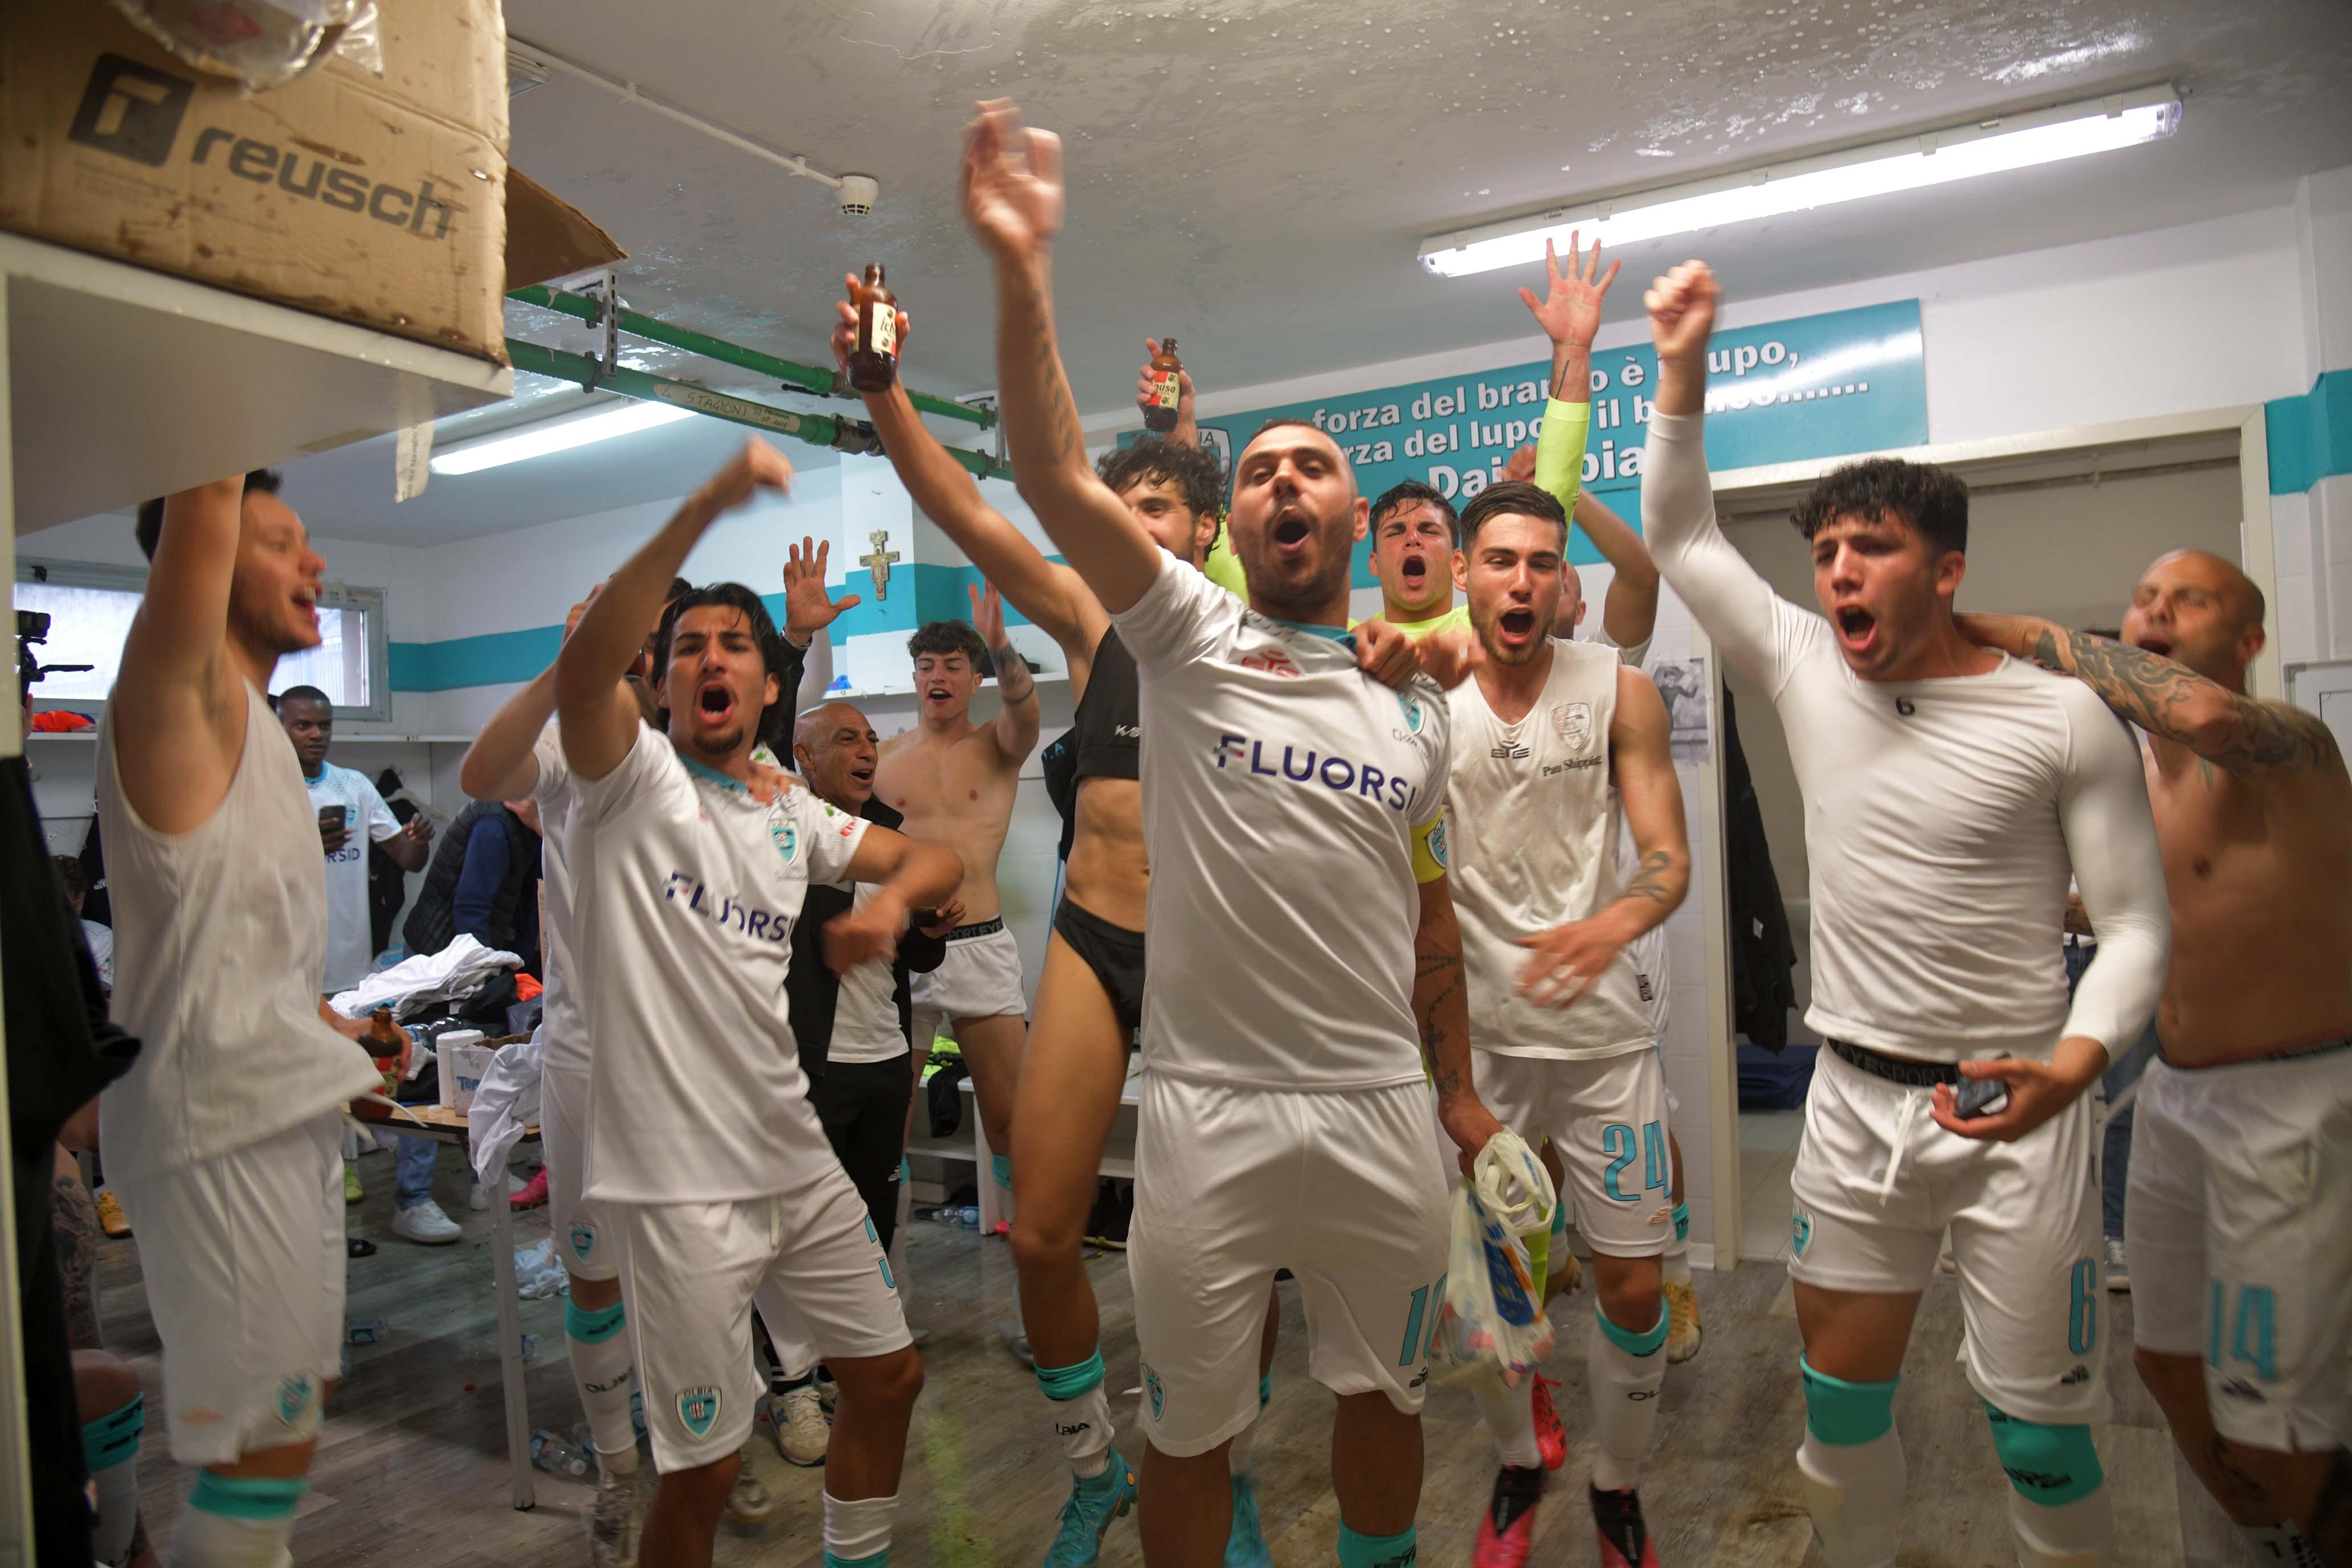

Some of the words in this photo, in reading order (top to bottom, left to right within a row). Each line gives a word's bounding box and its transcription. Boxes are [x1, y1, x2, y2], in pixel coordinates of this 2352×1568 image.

[190, 126, 452, 240] reusch
[1312, 403, 1400, 434] forza
[1411, 386, 1467, 422] del
[1620, 356, 1644, 387] è
[1707, 341, 1799, 377] upo,
[1348, 439, 1394, 466] rza
[1404, 423, 1459, 458] del
[1469, 416, 1543, 450] lupo
[1597, 398, 1622, 430] il
[1896, 696, 1916, 716] 6
[1213, 735, 1416, 812] FLUORSI
[663, 871, 795, 942] FLUORSI
[1603, 1120, 1672, 1202] 24
[2069, 1257, 2097, 1355] 6
[2208, 1278, 2279, 1383] 14
